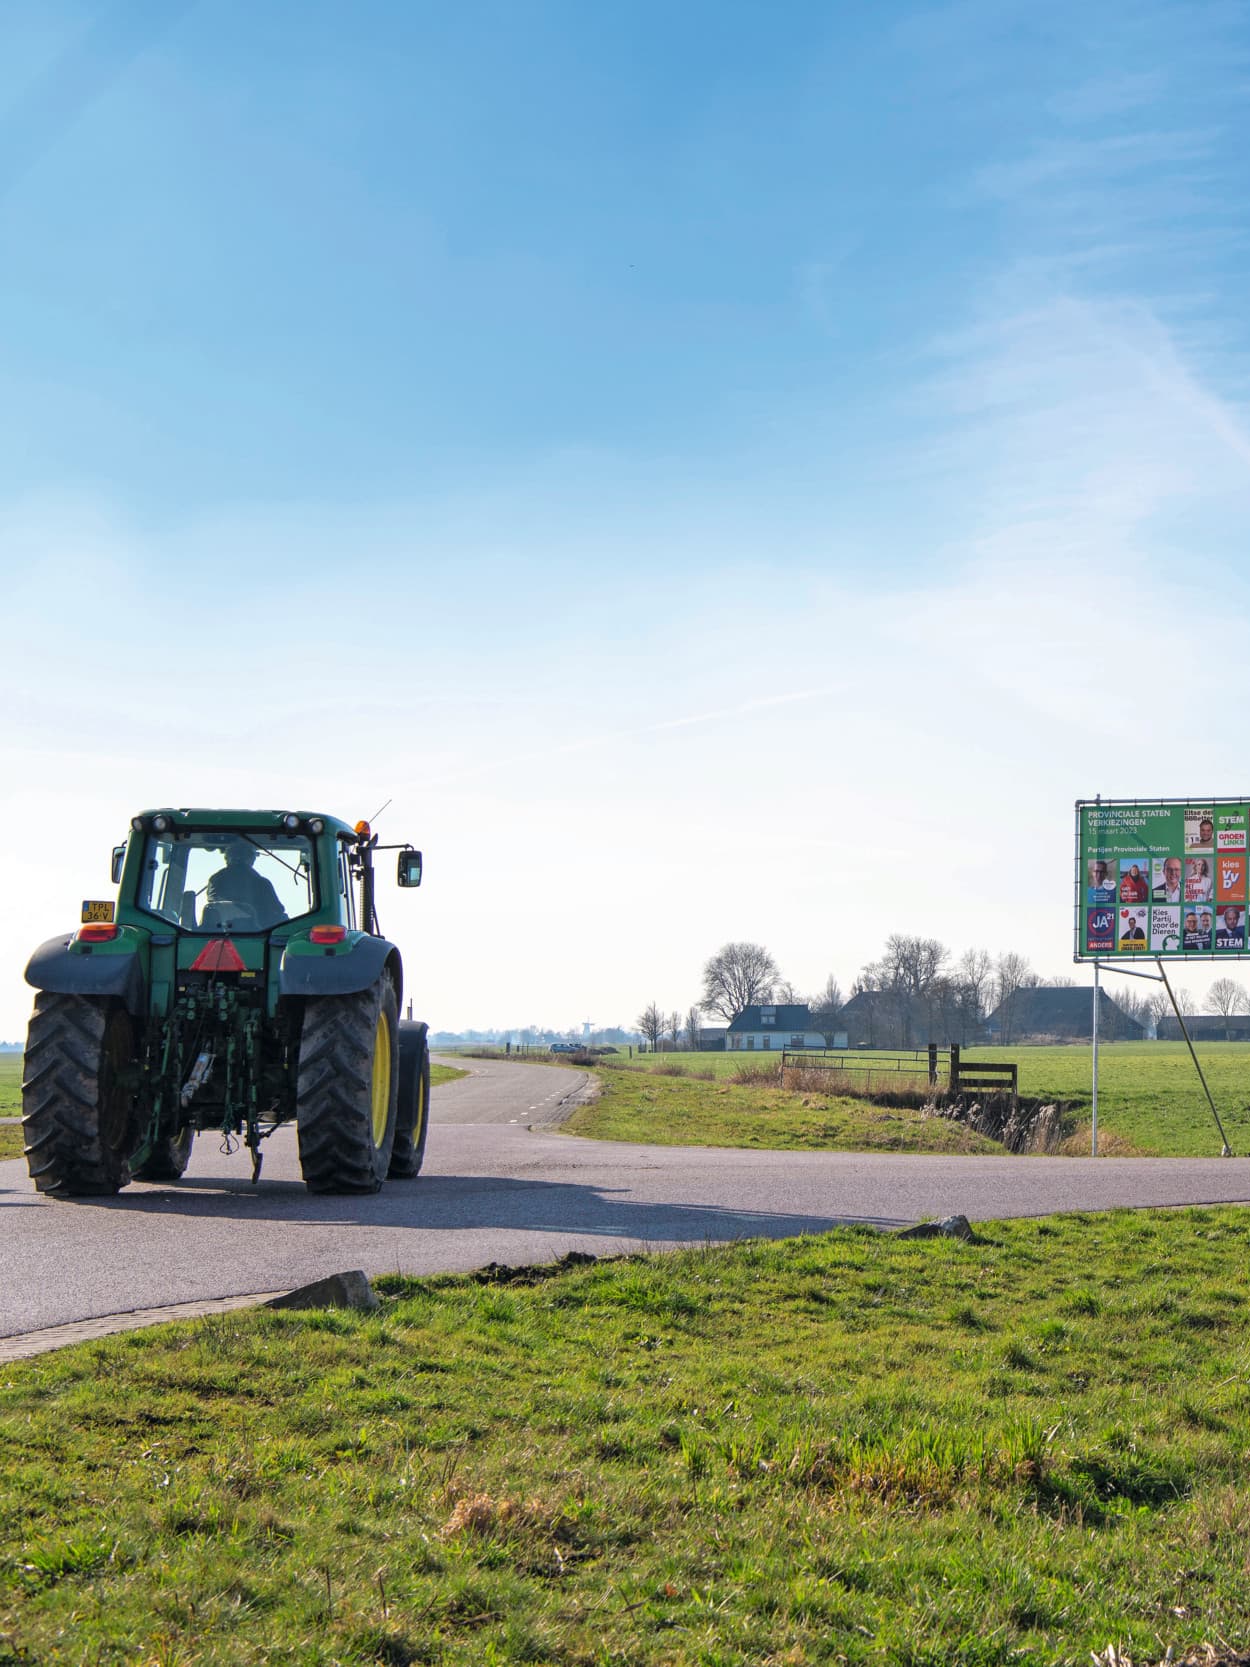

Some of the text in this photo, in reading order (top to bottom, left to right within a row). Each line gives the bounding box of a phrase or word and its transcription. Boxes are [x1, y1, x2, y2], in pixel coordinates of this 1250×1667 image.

[1219, 816, 1244, 824] STEM
[1087, 846, 1113, 854] Partijen
[1222, 860, 1240, 868] kies
[93, 903, 109, 911] TPL
[1216, 938, 1243, 947] STEM
